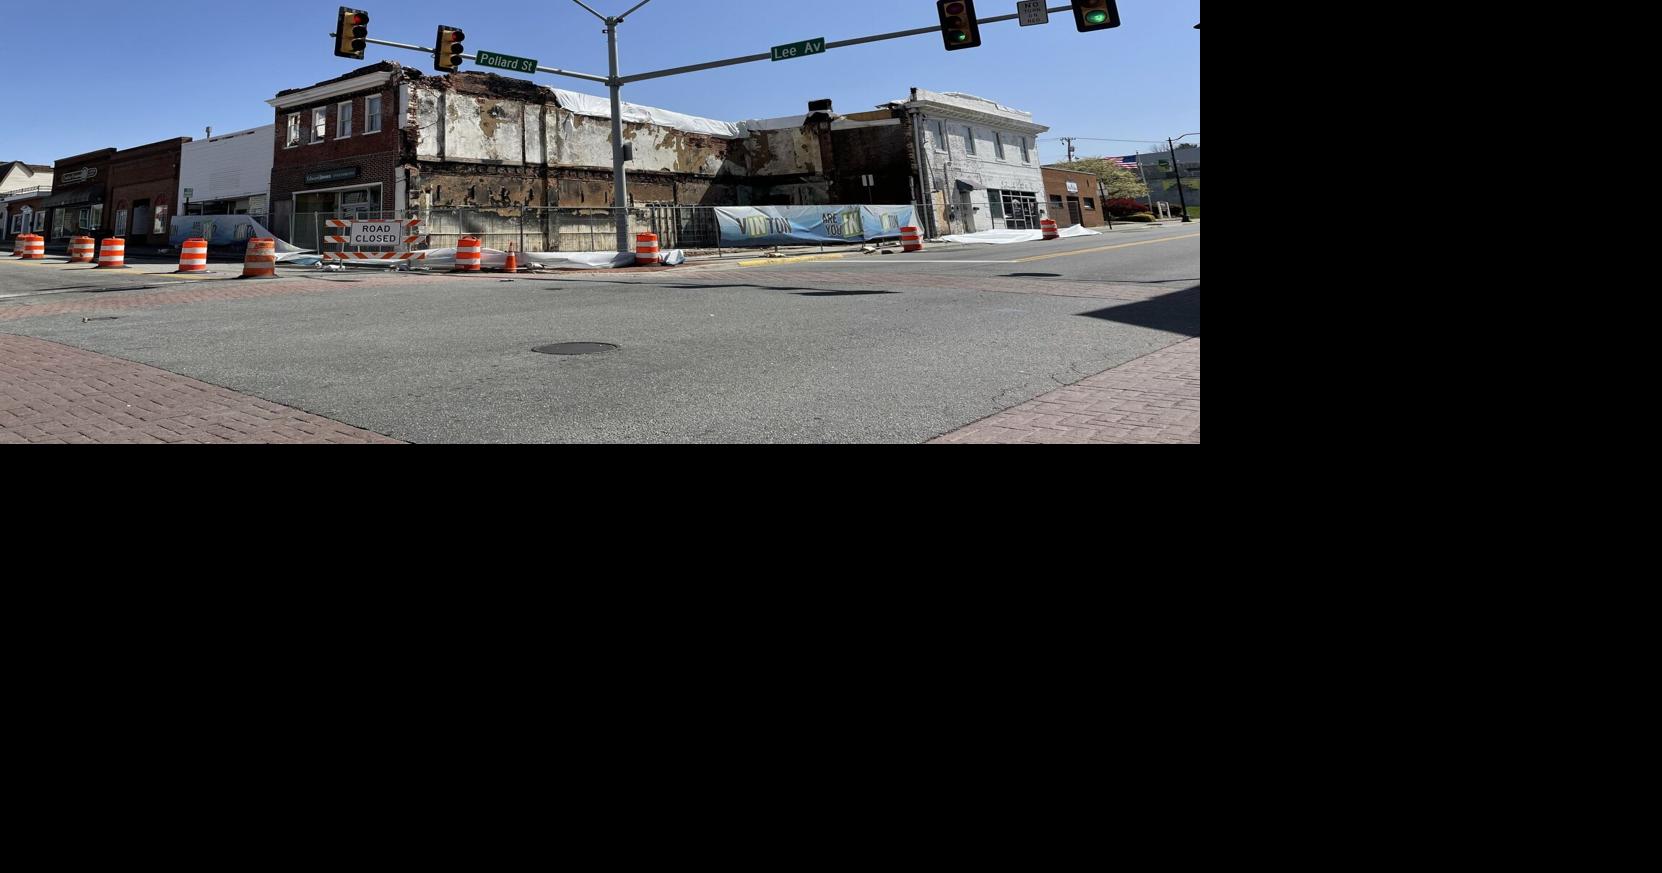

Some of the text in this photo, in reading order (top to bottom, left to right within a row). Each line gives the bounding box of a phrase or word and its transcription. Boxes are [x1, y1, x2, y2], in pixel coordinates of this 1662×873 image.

[774, 42, 821, 59] Lee Av
[480, 53, 533, 71] Pollard St
[822, 213, 838, 224] ARE
[362, 225, 391, 233] ROAD
[736, 217, 792, 236] VINTON
[825, 225, 842, 236] YOU
[355, 234, 396, 243] CLOSED
